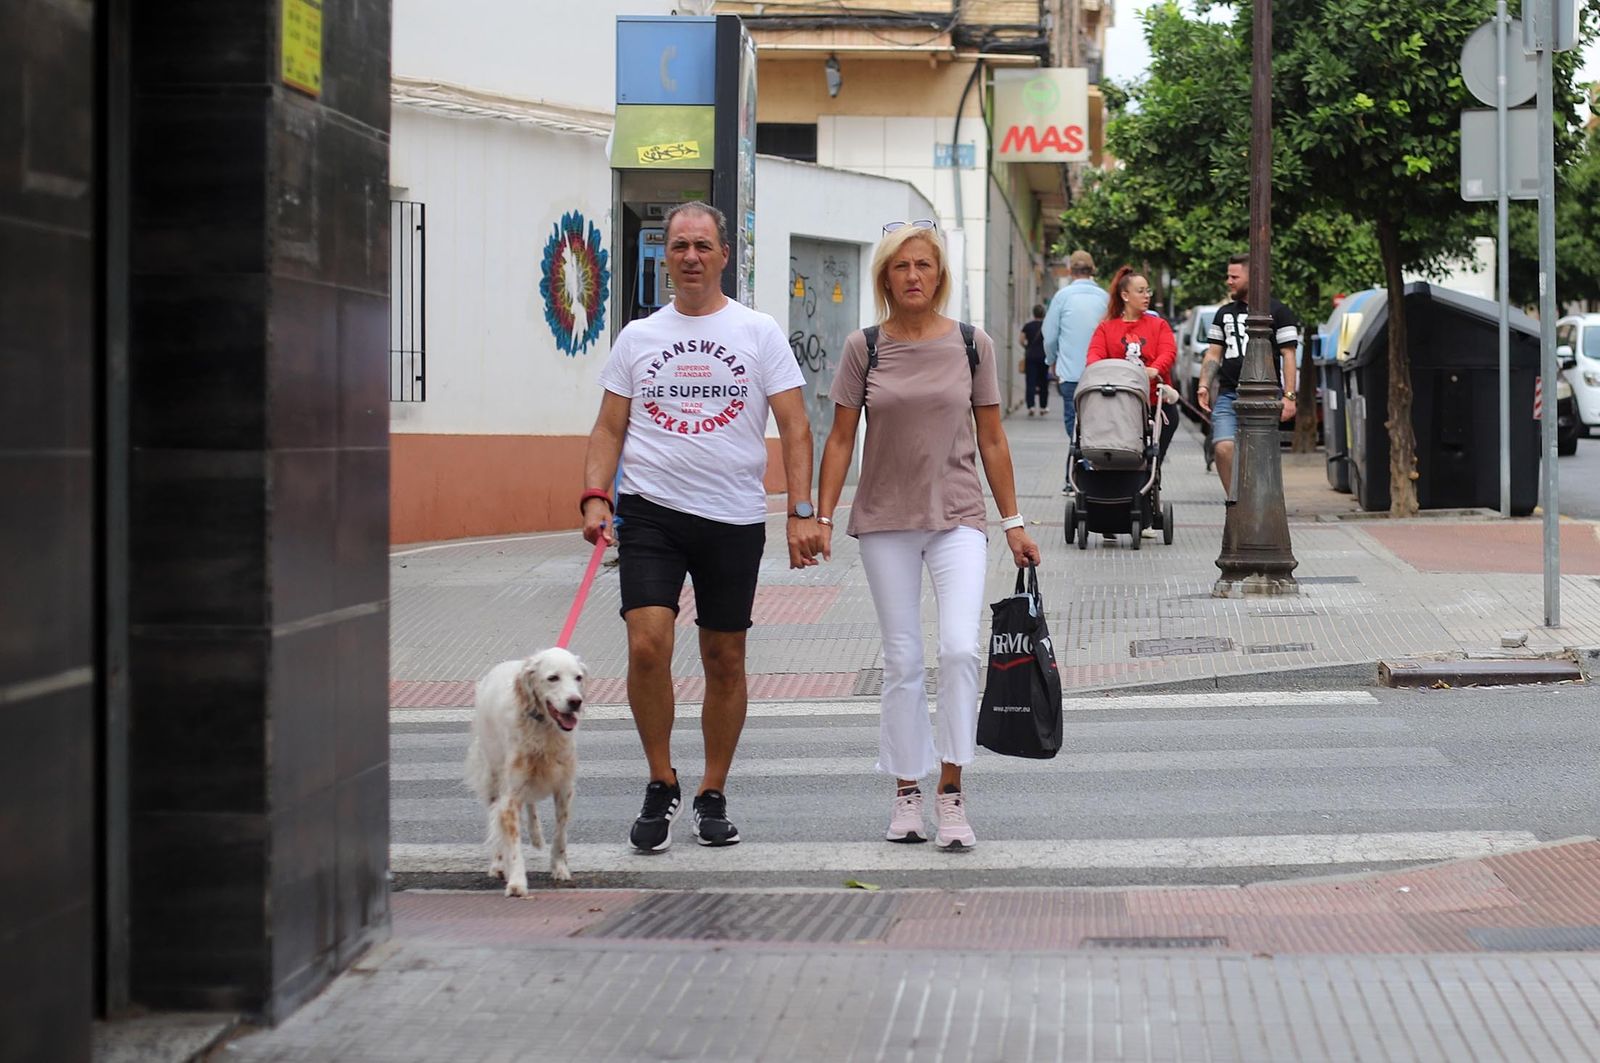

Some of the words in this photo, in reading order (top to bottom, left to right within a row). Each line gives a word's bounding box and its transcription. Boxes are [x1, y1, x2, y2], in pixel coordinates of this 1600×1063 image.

[999, 125, 1085, 154] MAS
[646, 339, 746, 378] JEANSWEAR
[641, 386, 665, 398] THE
[669, 385, 748, 398] SUPERIOR
